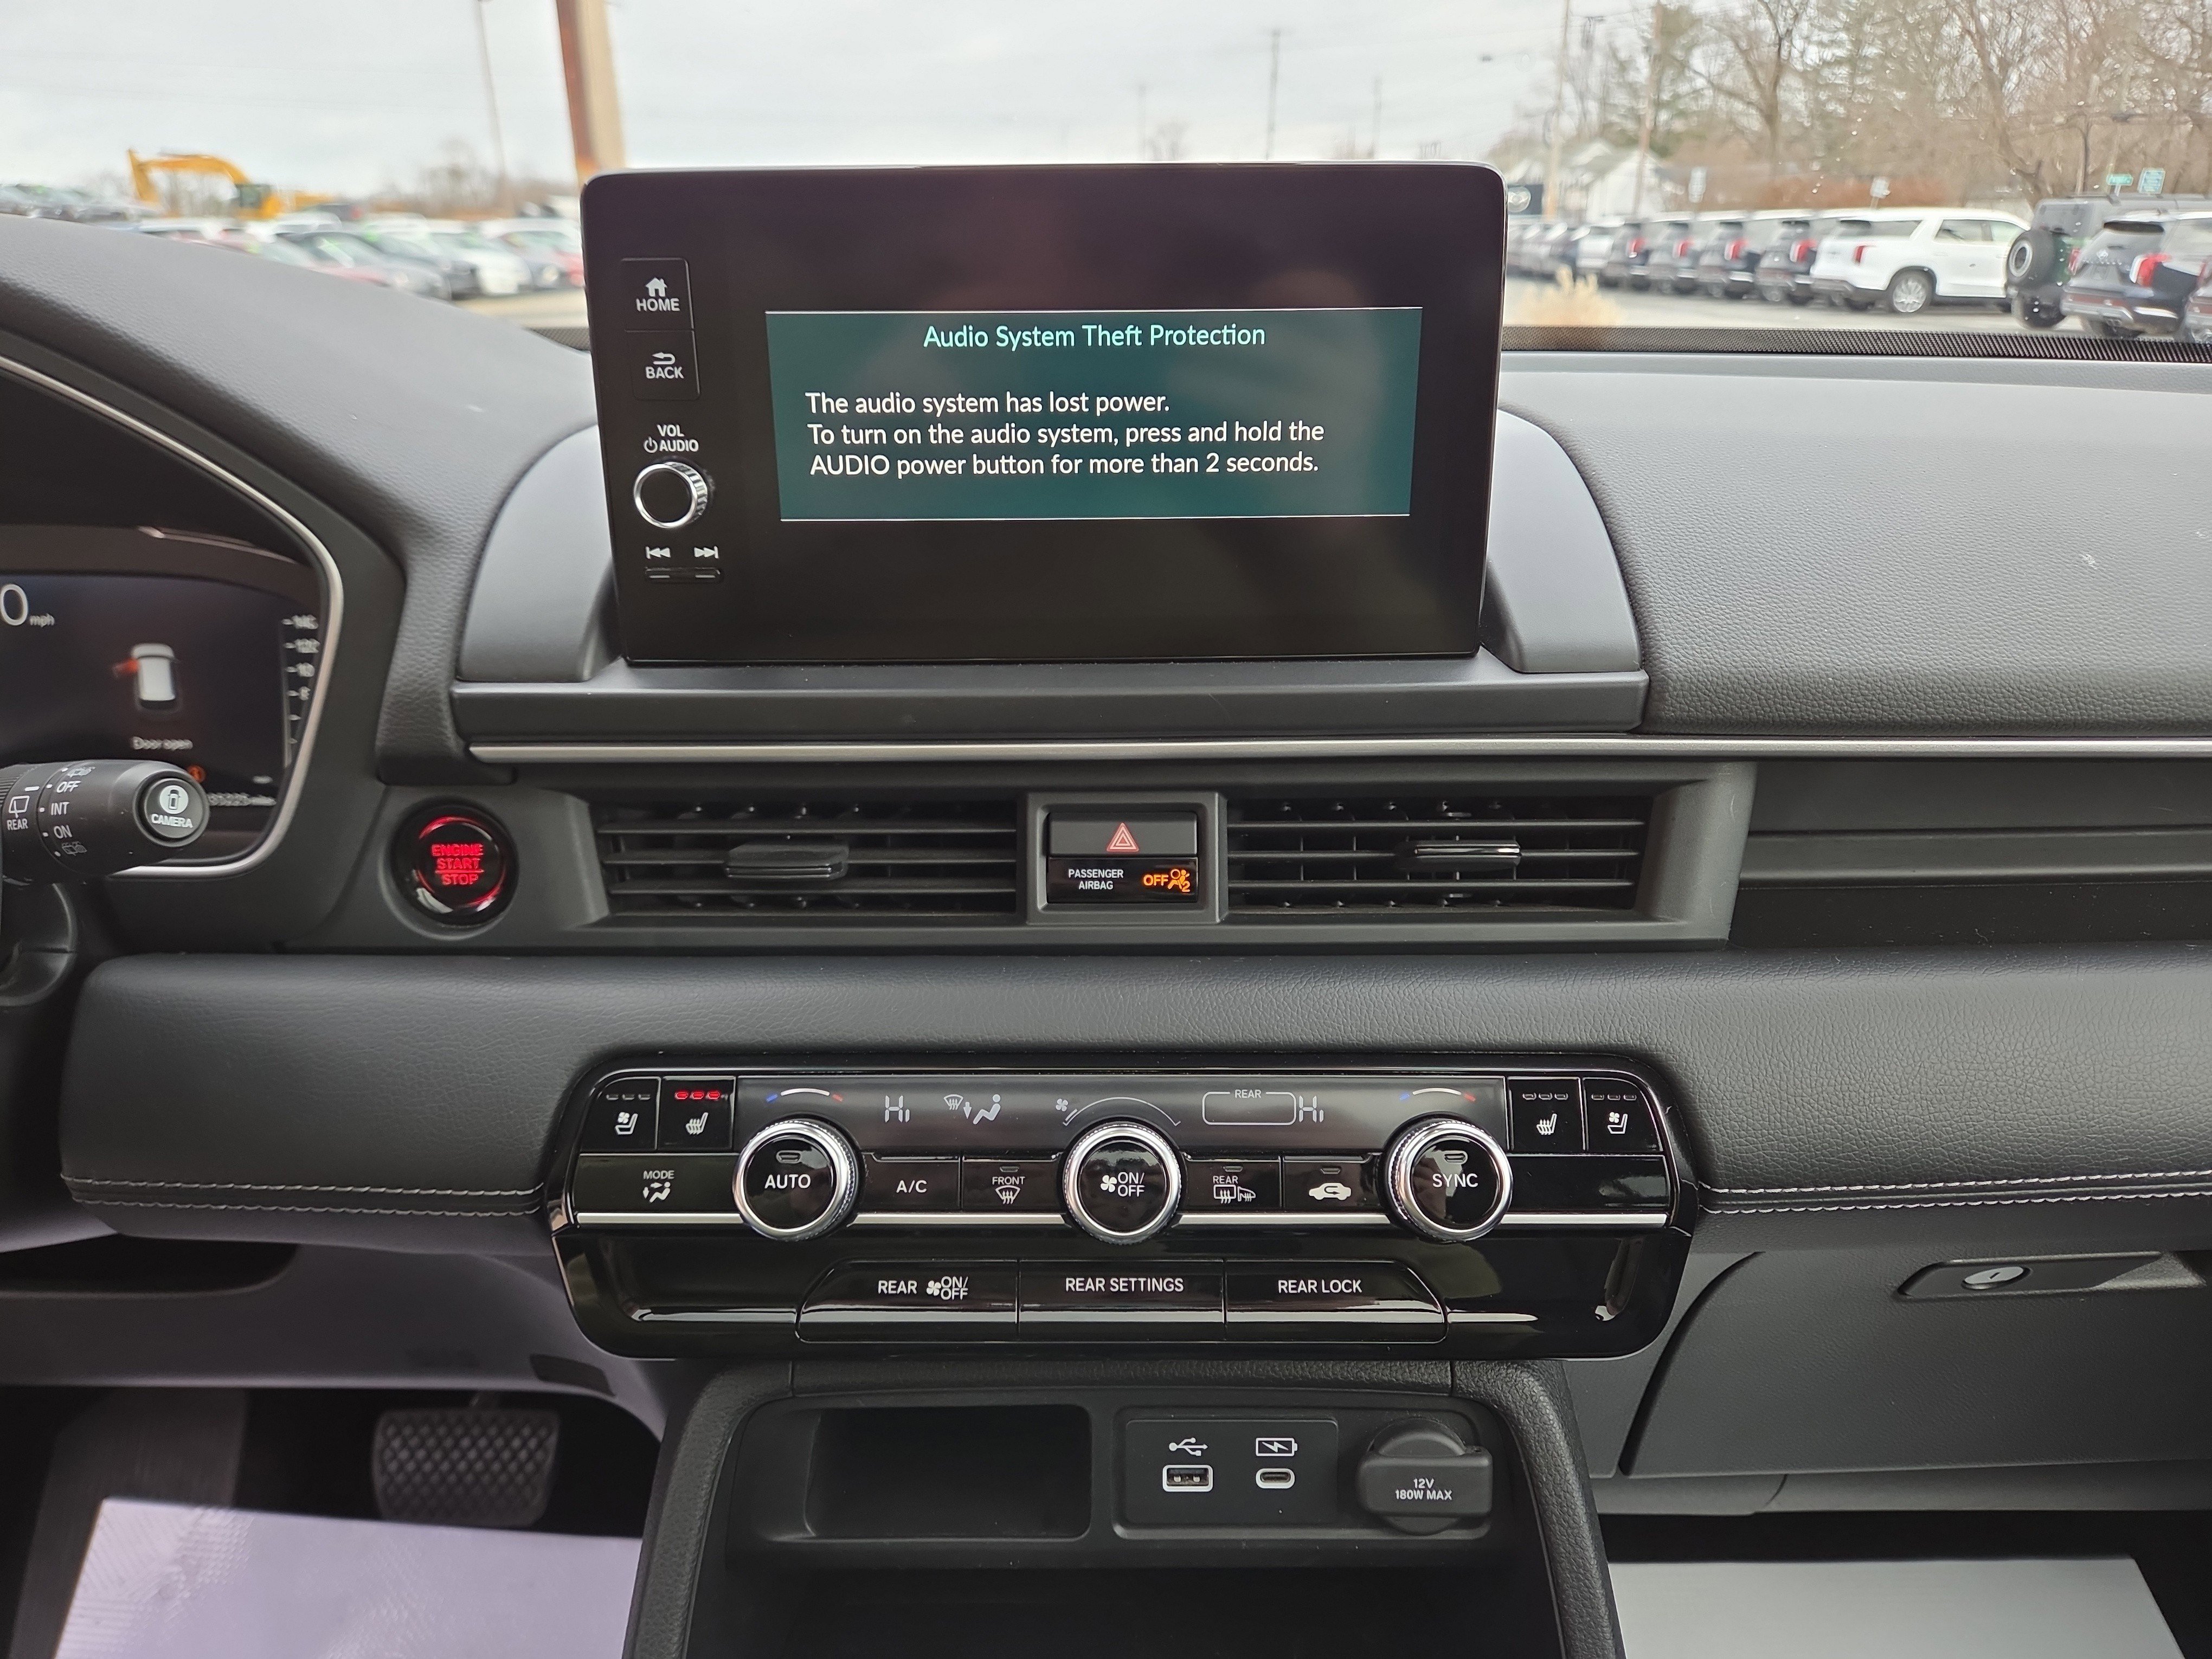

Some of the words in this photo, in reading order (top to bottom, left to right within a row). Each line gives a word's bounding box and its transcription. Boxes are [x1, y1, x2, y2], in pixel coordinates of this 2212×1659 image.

[636, 298, 680, 312] HOME
[923, 325, 988, 348] Audio
[996, 325, 1075, 352] System
[1082, 324, 1142, 346] Theft
[1150, 323, 1265, 346] Protection
[645, 366, 684, 380] BACK
[805, 391, 848, 414] The
[855, 391, 916, 414] audio
[923, 393, 999, 417] system
[1006, 391, 1043, 413] has
[1050, 391, 1089, 413] lost
[1096, 396, 1169, 416] power.
[657, 424, 685, 438] VOL
[807, 423, 835, 445] To
[841, 425, 887, 445] turn
[893, 429, 921, 444] on
[928, 423, 964, 444] the
[970, 422, 1031, 443] audio
[1038, 423, 1118, 448] system,
[1126, 427, 1181, 447] press
[1188, 421, 1227, 442] and
[1235, 420, 1282, 442] hold
[1289, 420, 1324, 441] the
[659, 439, 699, 452] AUDIO
[810, 454, 890, 475] AUDIO
[897, 459, 967, 479] power
[973, 453, 1044, 474] button
[1051, 454, 1083, 474] for
[1090, 458, 1144, 474] more
[1150, 452, 1199, 473] than
[1206, 452, 1219, 472] 2
[1226, 451, 1319, 472] seconds.
[30, 613, 55, 628] mph
[132, 736, 162, 750] Door
[56, 780, 81, 793] OFF
[50, 801, 70, 815] INT
[7, 818, 28, 831] REAR
[151, 814, 194, 829] CAMERA
[53, 825, 72, 839] ON
[432, 843, 484, 857] ENGINE
[437, 858, 481, 870] START
[441, 874, 479, 885] STOP
[1068, 869, 1124, 878] PASSENGER
[1143, 874, 1168, 886] OFF
[1078, 880, 1114, 890] AIRBAG
[1234, 1089, 1262, 1099] REAR
[643, 1170, 674, 1180] MODE
[764, 1174, 811, 1189] AUTO
[992, 1176, 1026, 1186] FRONT
[1212, 1175, 1238, 1184] REAR
[1432, 1173, 1479, 1188] SYNC
[896, 1180, 927, 1193] A/C
[1117, 1185, 1145, 1197] OFF
[878, 1280, 917, 1294] REAR
[1065, 1277, 1105, 1292] REAR
[1110, 1277, 1184, 1292] SETTINGS
[1278, 1279, 1317, 1294] REAR
[1321, 1279, 1362, 1293] LOCK
[941, 1288, 969, 1301] OFF
[1413, 1478, 1435, 1489] 12V
[1395, 1489, 1424, 1500] 180W
[1426, 1489, 1453, 1501] MAX
